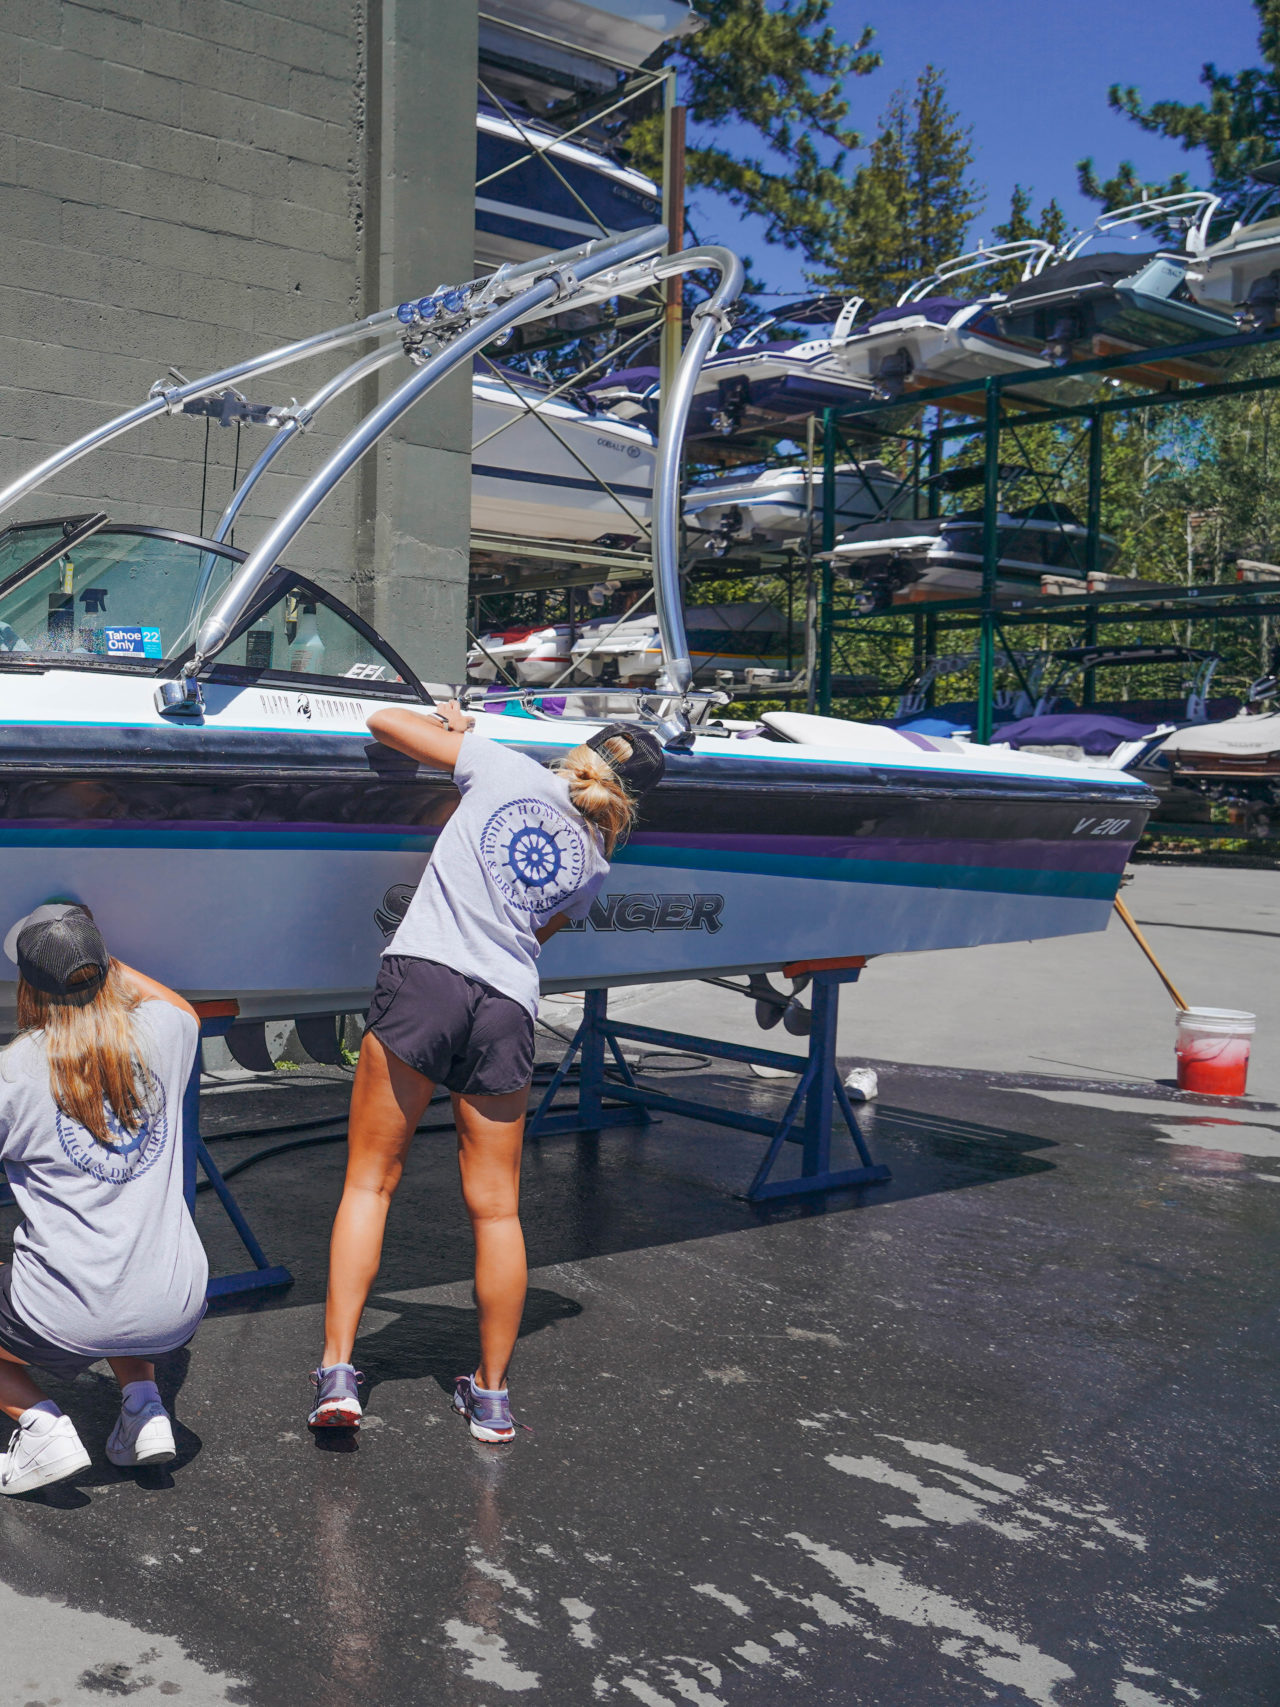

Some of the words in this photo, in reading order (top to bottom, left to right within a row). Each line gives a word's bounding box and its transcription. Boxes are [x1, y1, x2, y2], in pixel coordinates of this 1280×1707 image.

[105, 630, 142, 641] Tahoe
[108, 639, 135, 652] Only
[143, 631, 160, 643] 22
[485, 815, 507, 854] HIGH
[1071, 817, 1097, 835] V
[1090, 818, 1132, 836] 210
[494, 873, 520, 900] DRY
[373, 883, 725, 938] SNGER
[63, 1126, 93, 1166] HIGH
[94, 1162, 105, 1175] &
